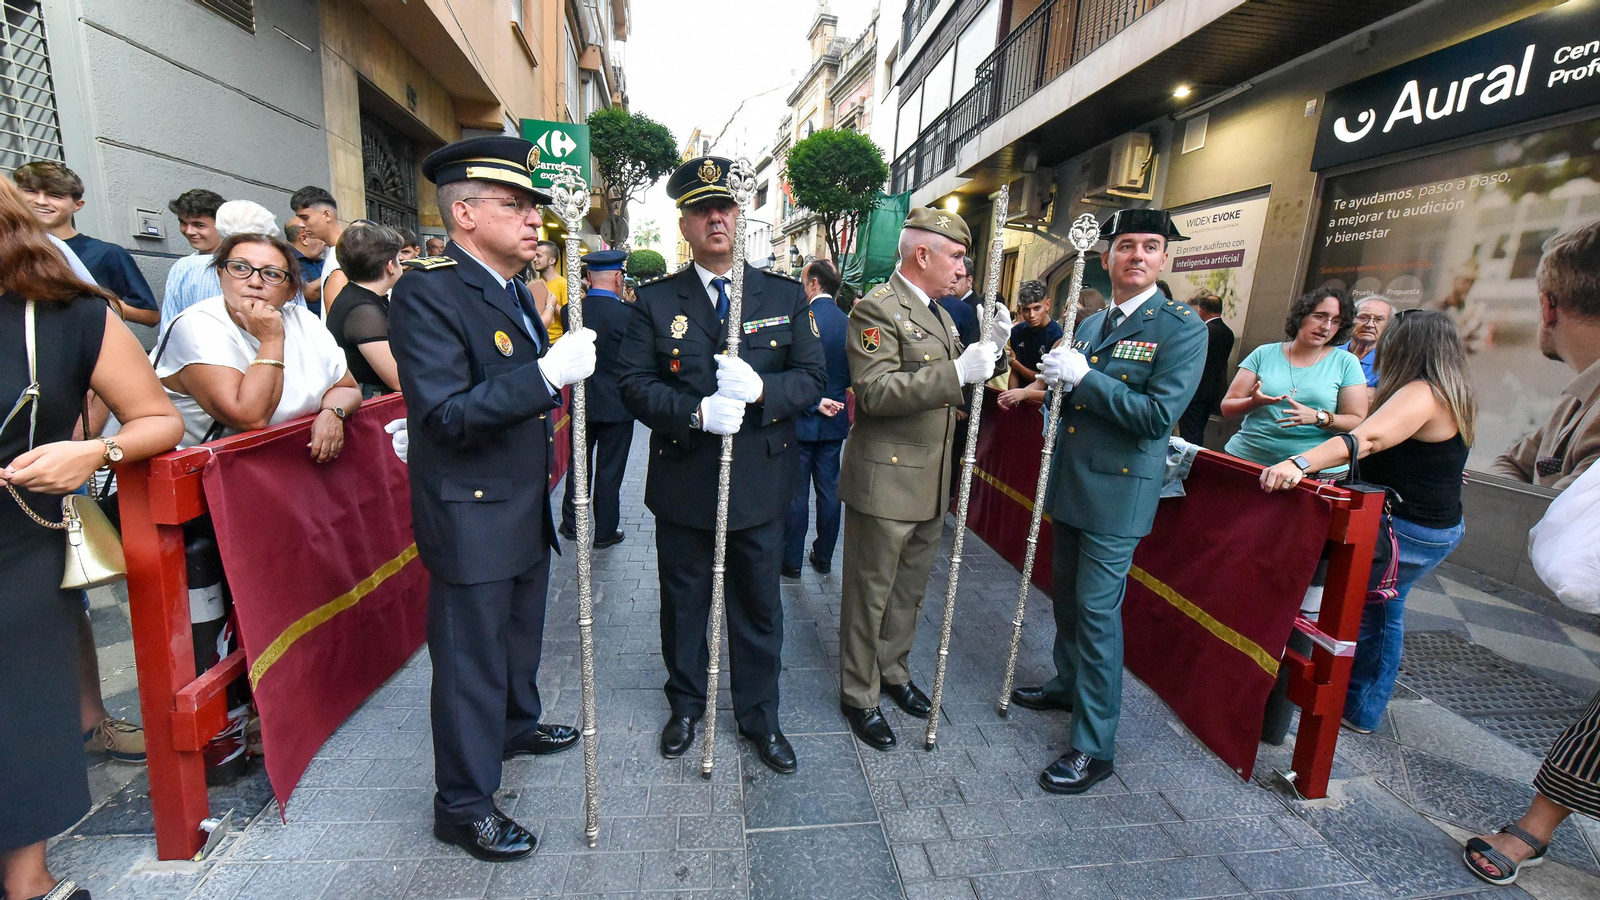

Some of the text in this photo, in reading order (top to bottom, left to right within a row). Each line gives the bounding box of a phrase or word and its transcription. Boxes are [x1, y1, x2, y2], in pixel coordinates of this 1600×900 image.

[1553, 40, 1600, 65] Cen
[1383, 44, 1535, 133] Aural
[1333, 171, 1511, 211] Te ayudamos, paso a paso,
[1186, 209, 1242, 228] WIDEX EVOKE
[1328, 198, 1464, 228] a mejorar tu audición
[1176, 246, 1182, 255] El
[1182, 244, 1202, 255] primer
[1232, 239, 1245, 248] con
[1325, 227, 1391, 247] y bienestar
[1175, 253, 1240, 269] inteligencia artificial
[1386, 287, 1420, 297] Propuesta
